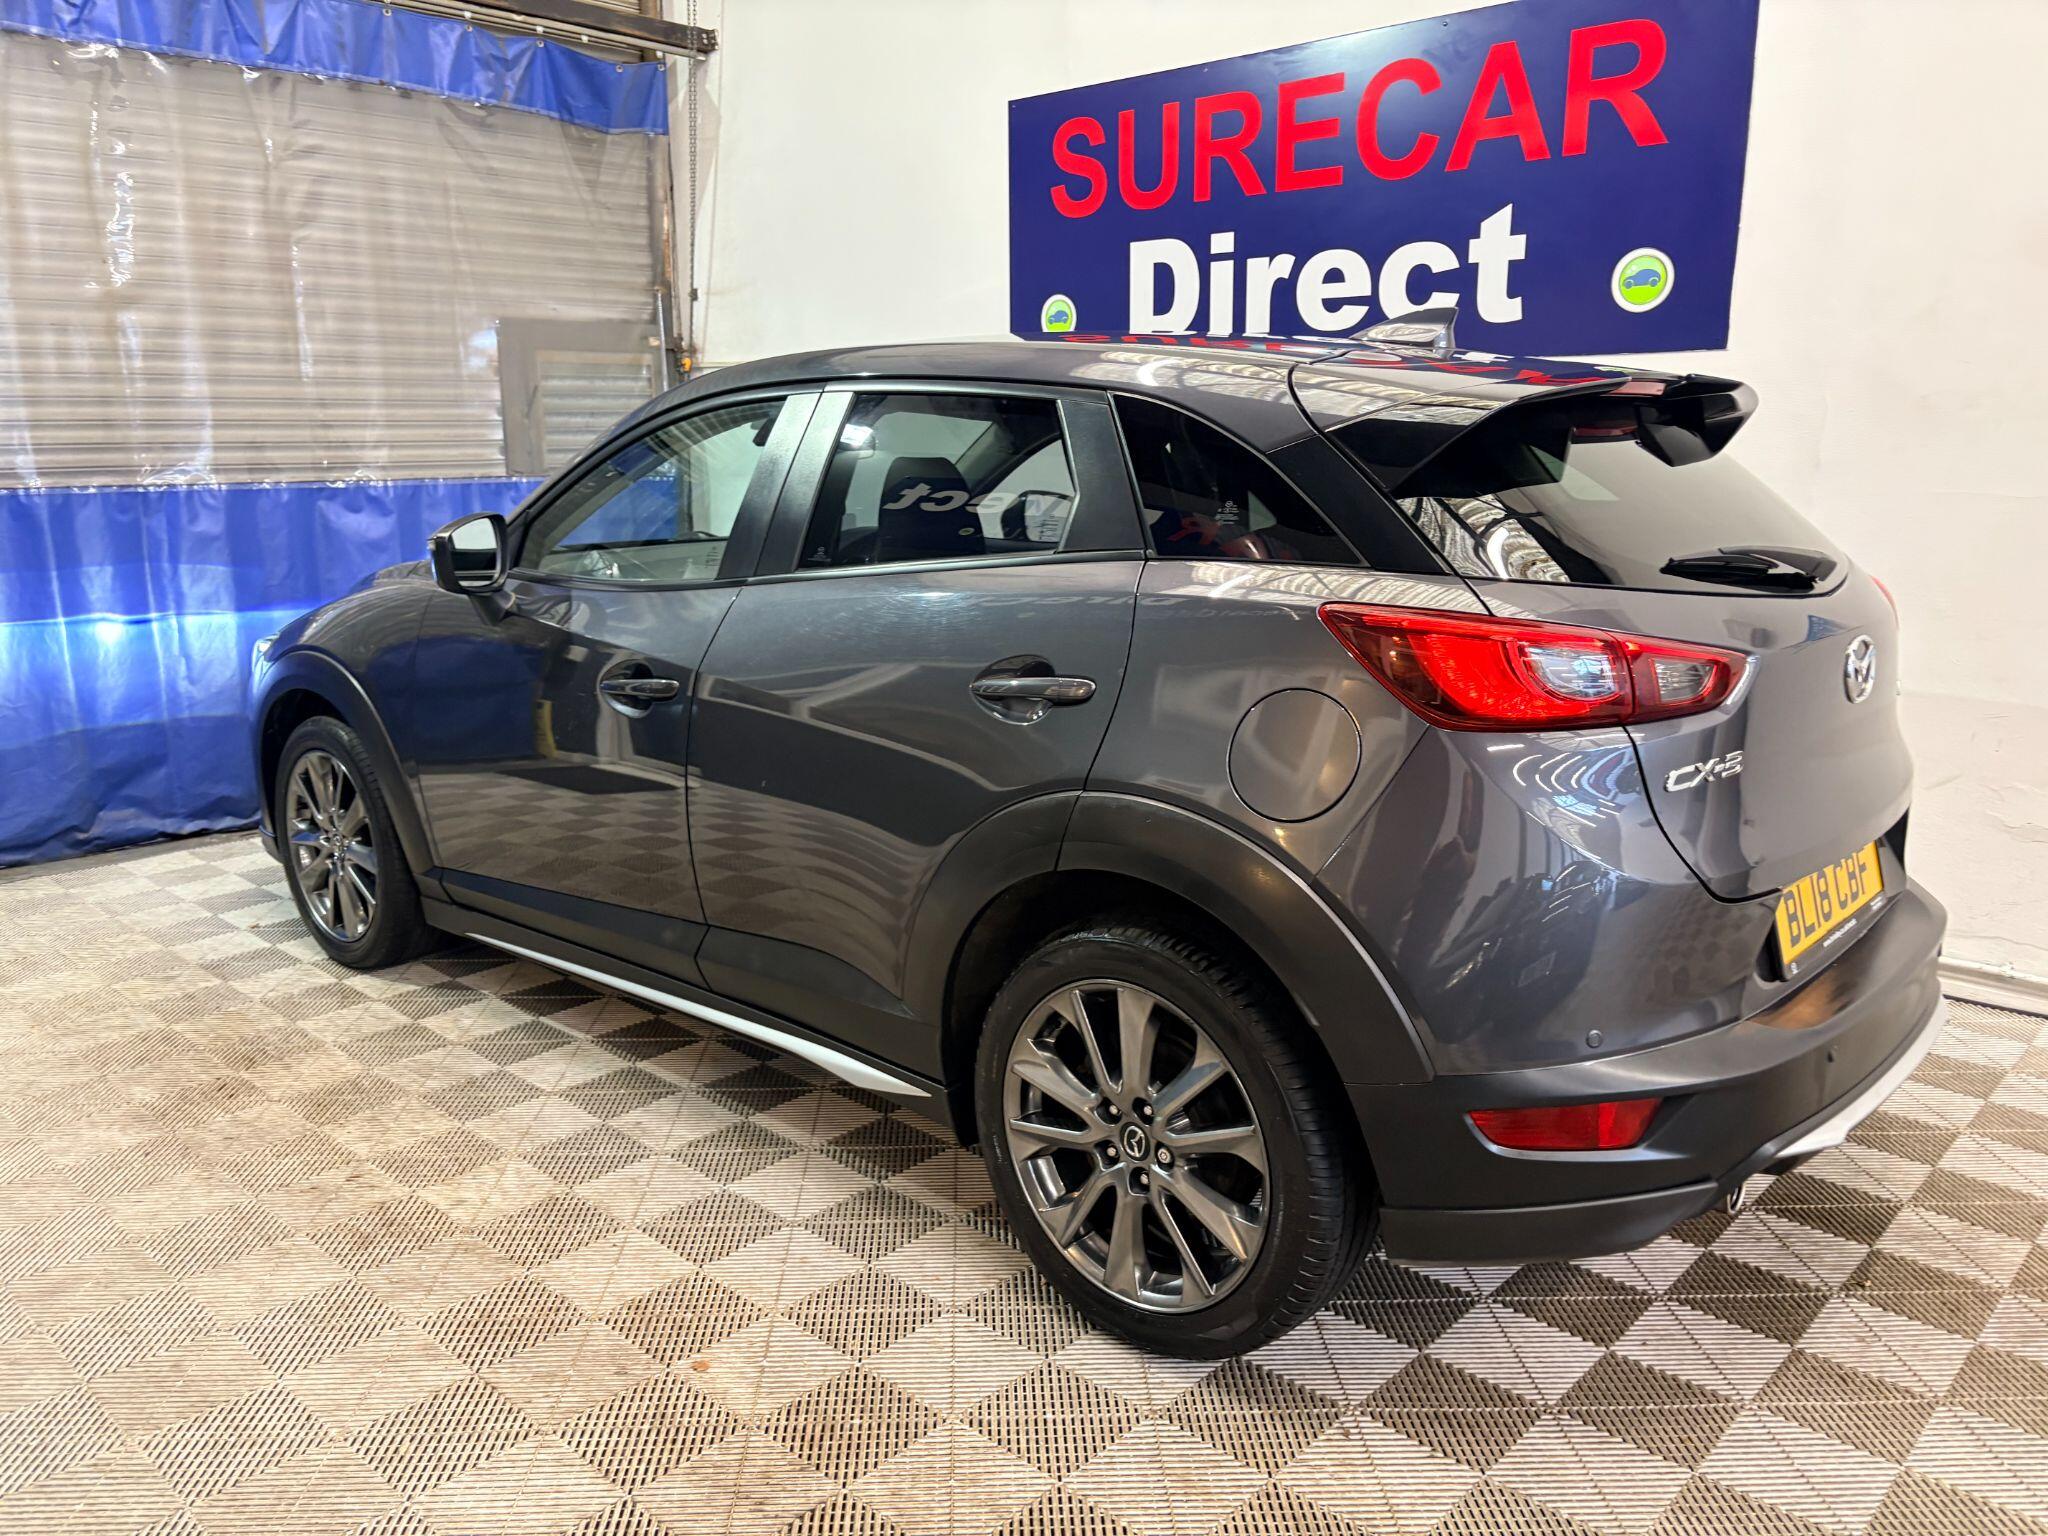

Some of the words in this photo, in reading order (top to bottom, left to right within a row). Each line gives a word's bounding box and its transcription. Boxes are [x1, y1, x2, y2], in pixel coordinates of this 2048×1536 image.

[1050, 18, 1669, 218] SURECAR
[1129, 203, 1527, 337] Direct
[1783, 869, 1832, 949] BL18
